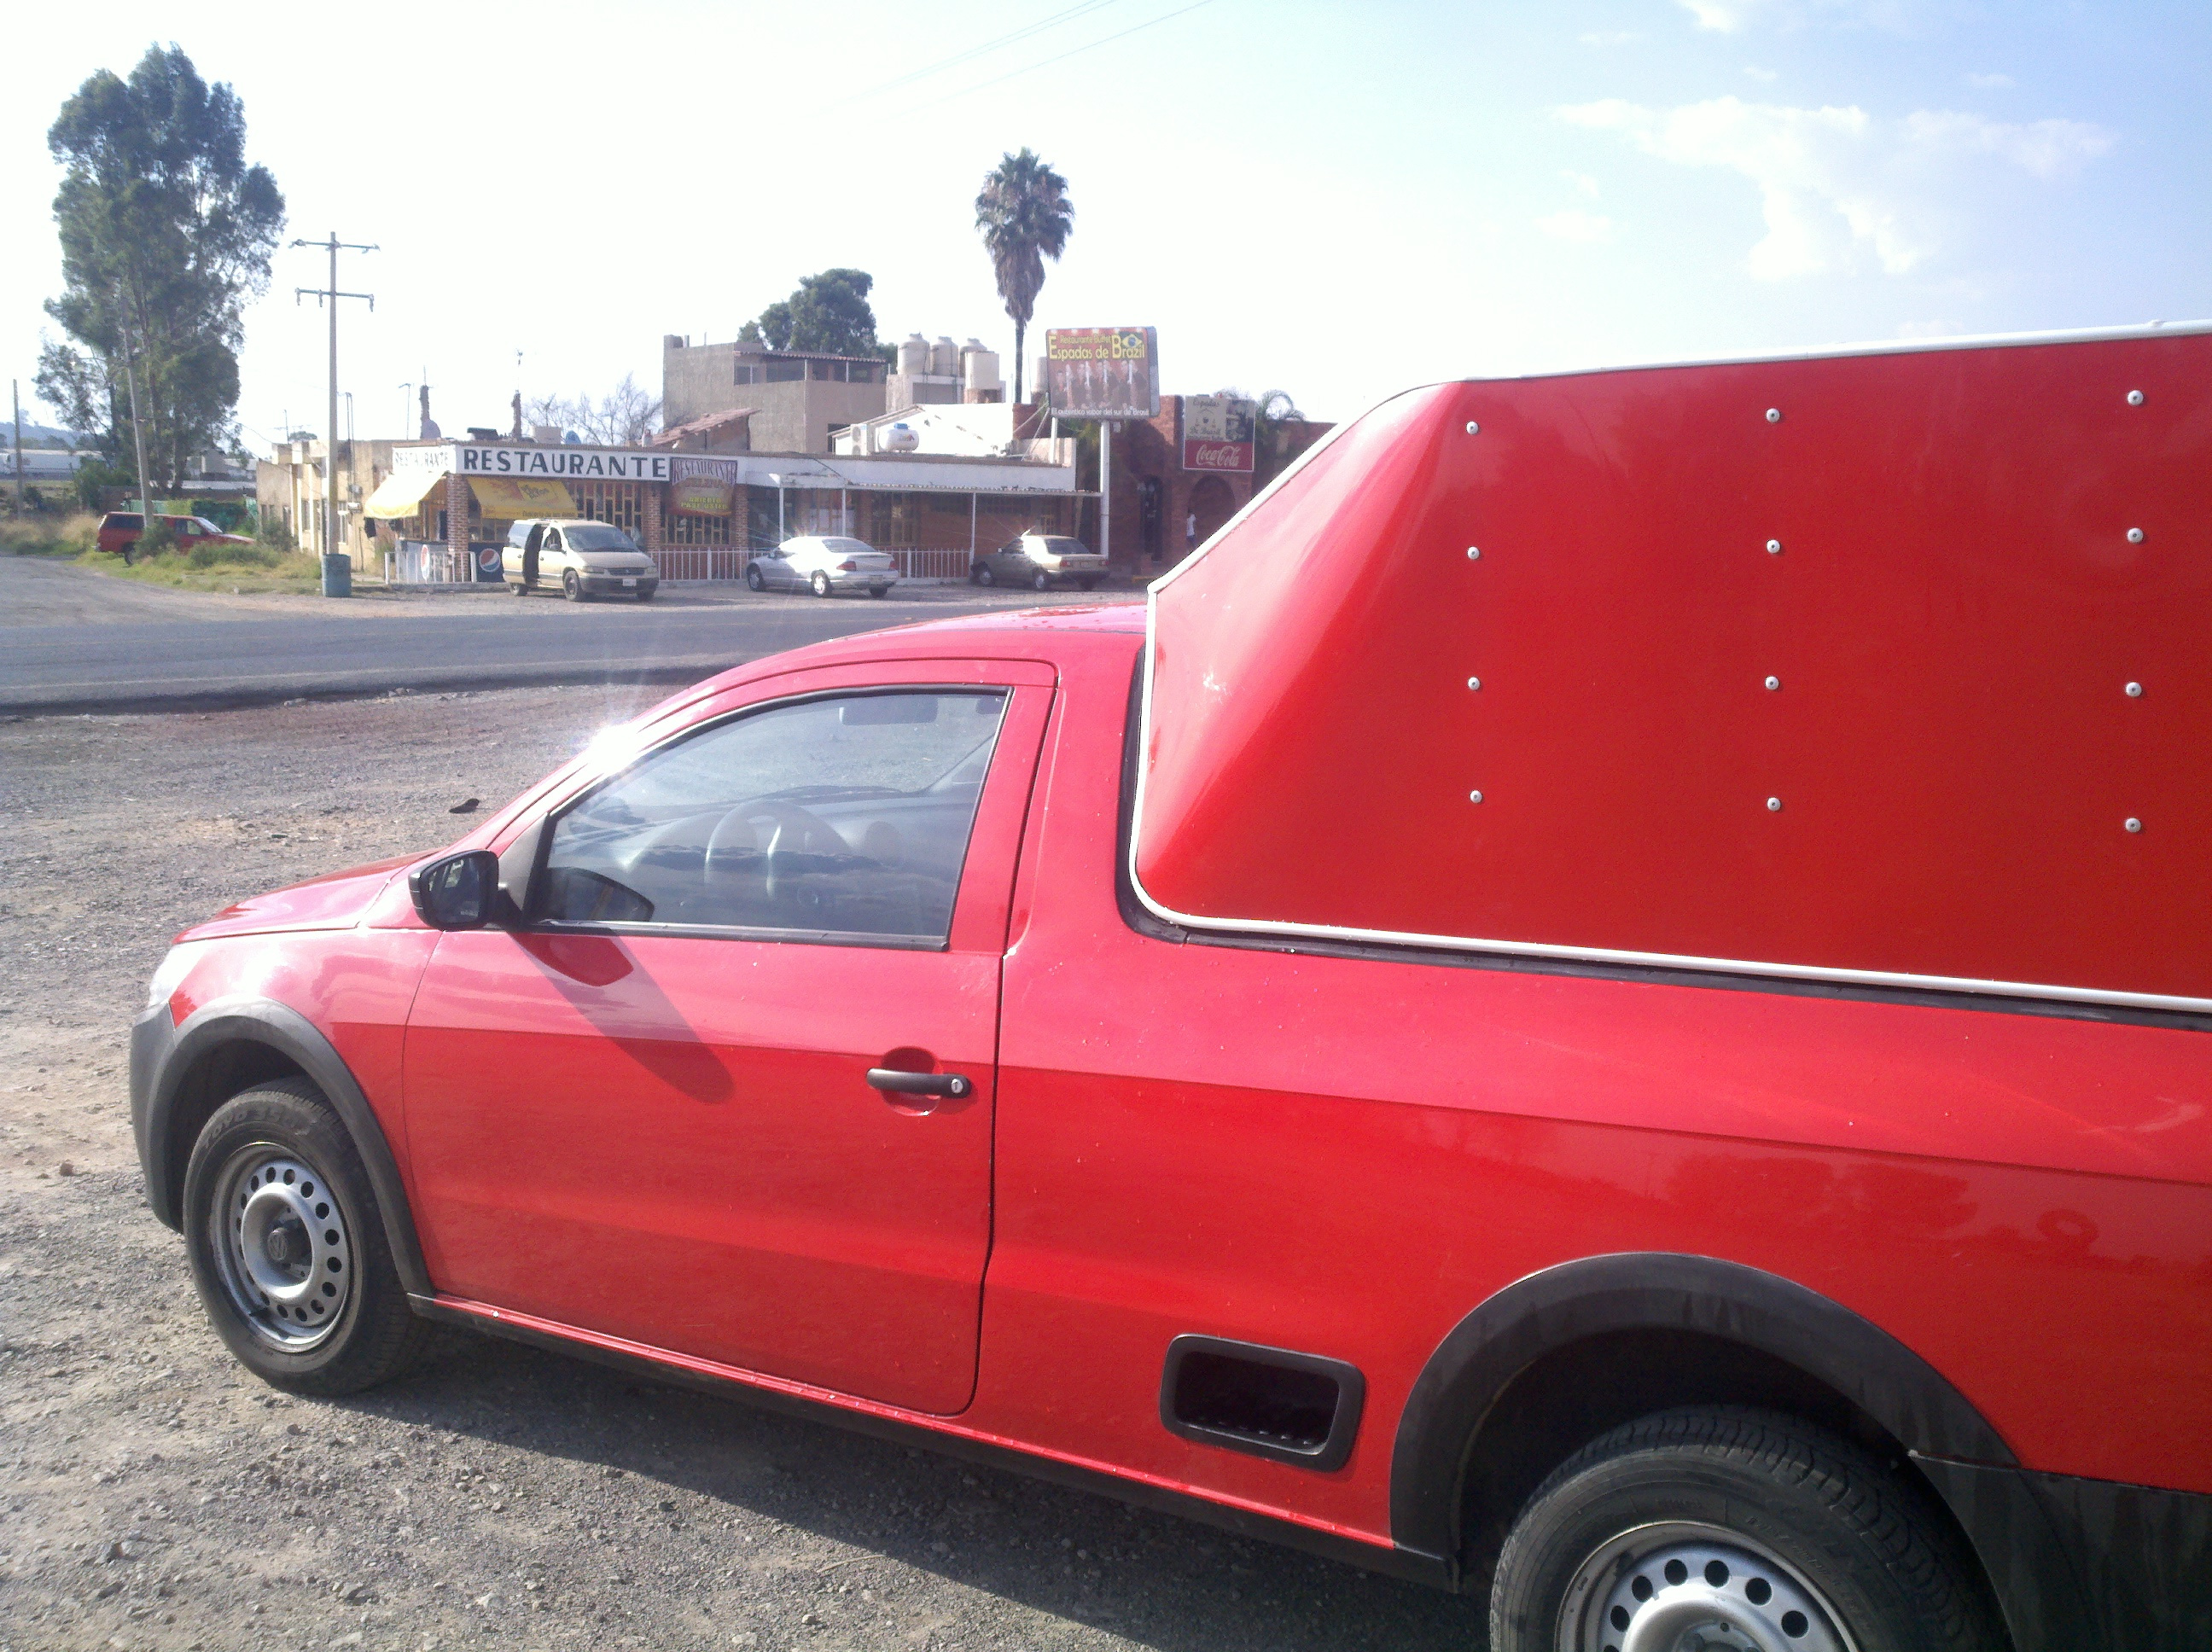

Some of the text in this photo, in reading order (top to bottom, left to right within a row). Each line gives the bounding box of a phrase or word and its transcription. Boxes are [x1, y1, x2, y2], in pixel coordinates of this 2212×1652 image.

[1048, 334, 1145, 362] Espadas de Brazil
[394, 451, 449, 468] RESTARANTE
[463, 449, 667, 478] RESTAURANTE
